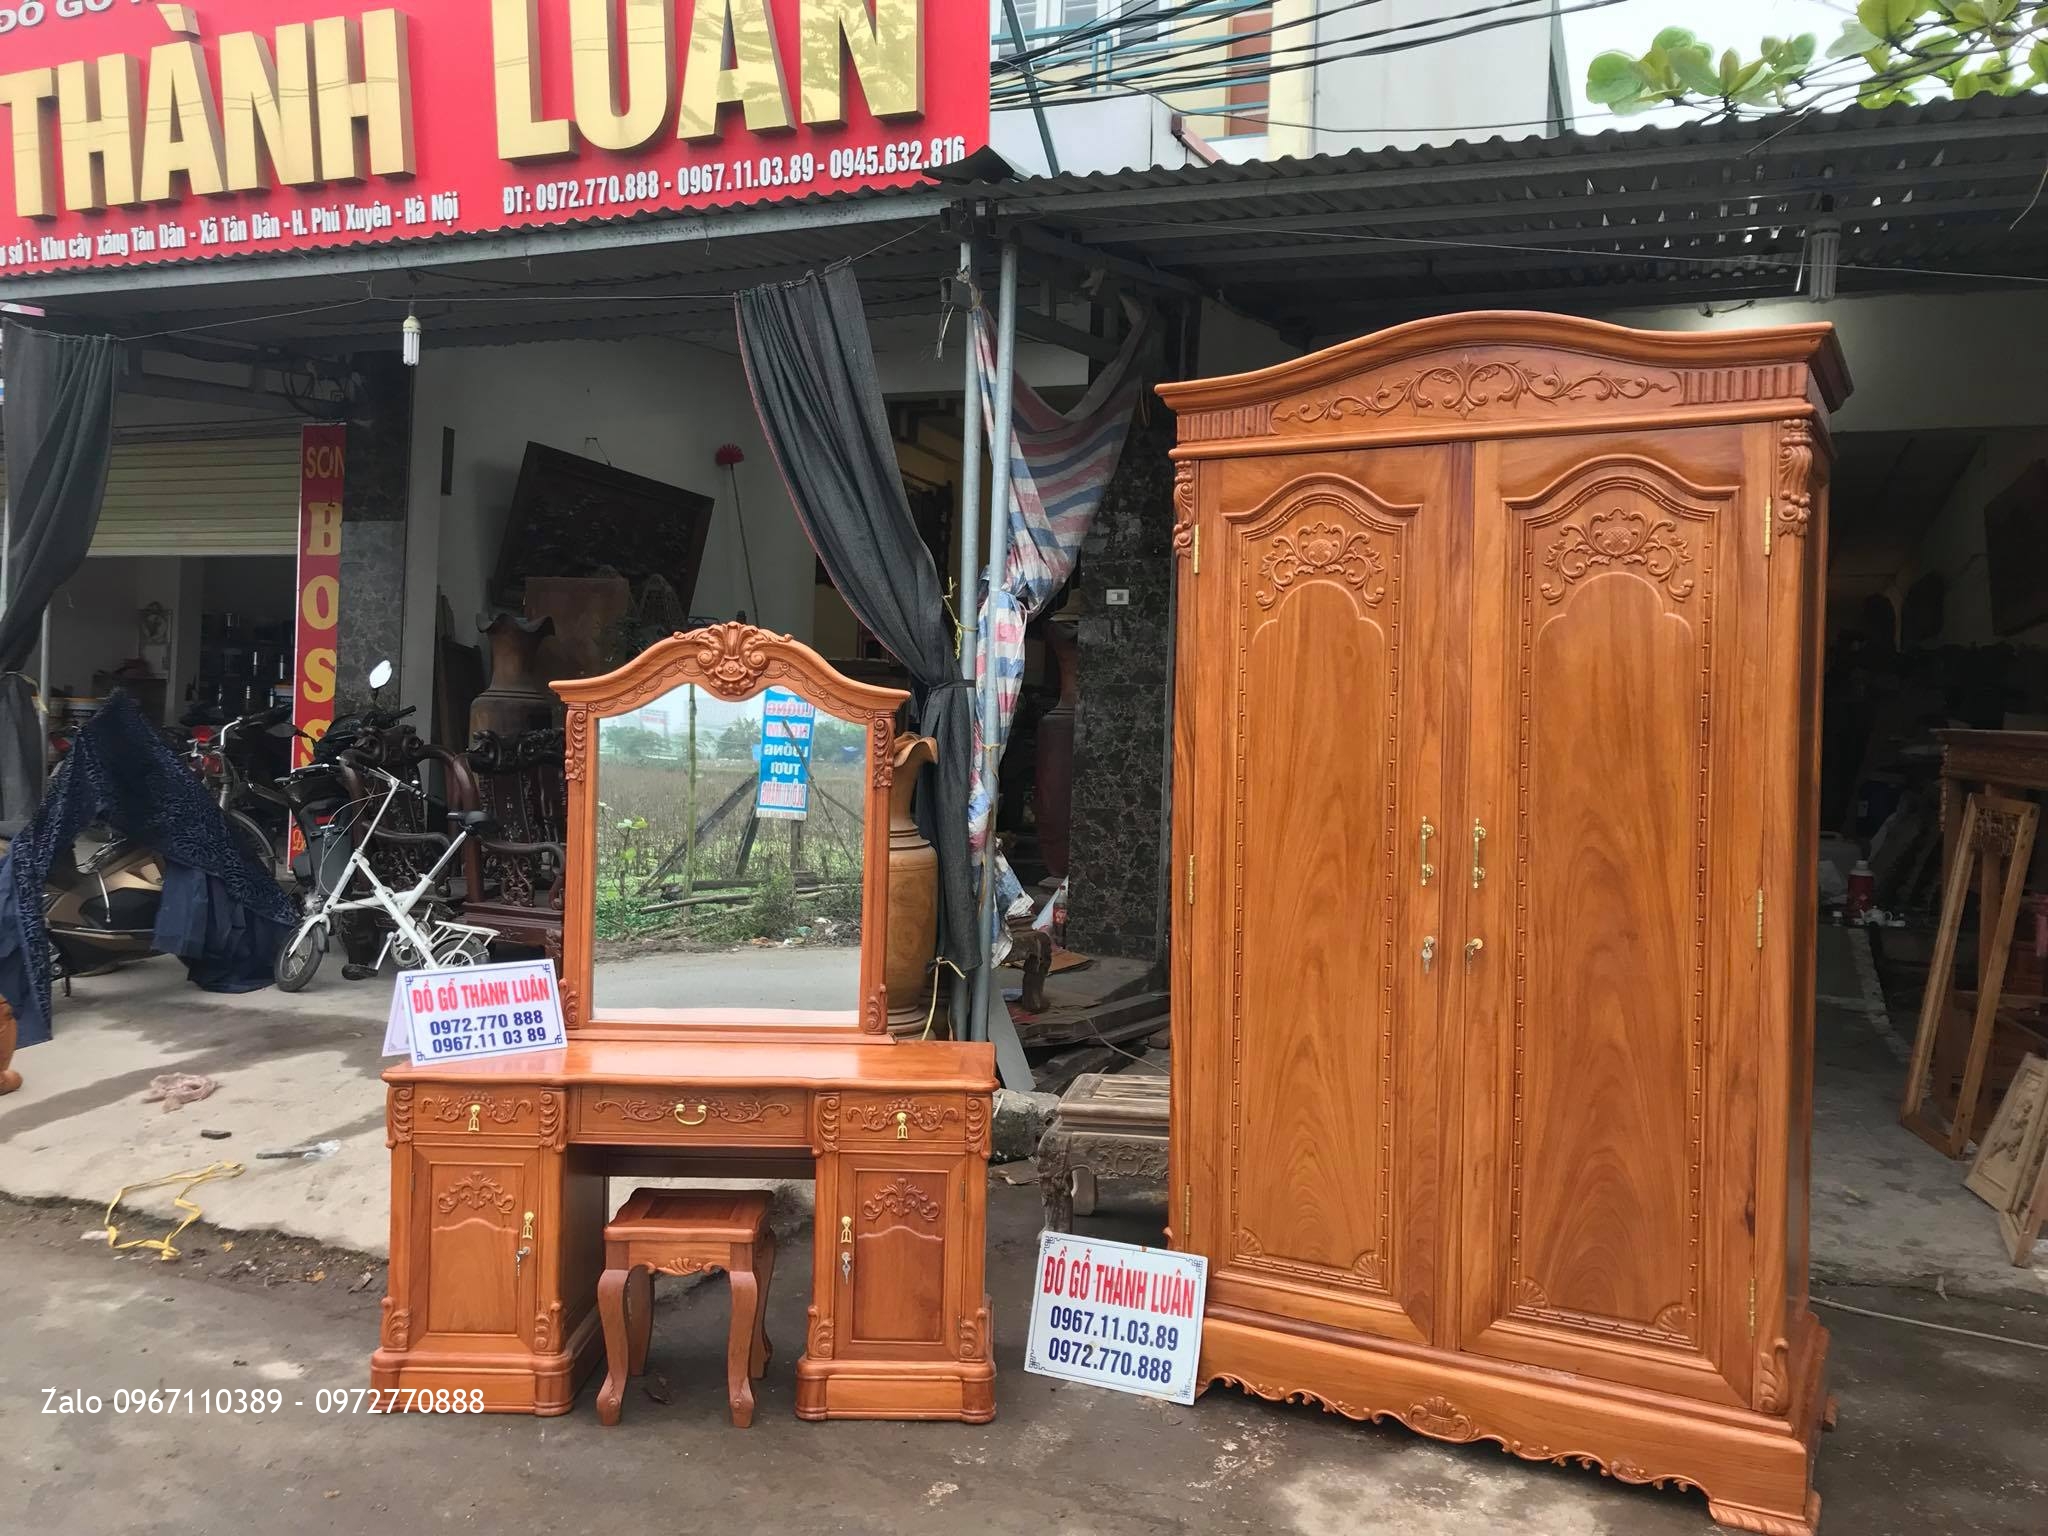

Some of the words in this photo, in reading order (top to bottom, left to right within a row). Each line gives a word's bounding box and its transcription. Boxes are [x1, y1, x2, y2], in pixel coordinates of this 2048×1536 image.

[0, 4, 414, 220] THÀNH
[503, 186, 532, 214] ĐT:
[536, 170, 659, 212] 0972.770.888
[678, 152, 814, 196] 0967.11.03.89
[830, 135, 966, 179] 0945.632.816
[41, 236, 67, 262] Khu
[69, 232, 92, 260] cây
[97, 229, 129, 257] xăng
[131, 225, 155, 252] Tân
[159, 221, 186, 249] Dân
[200, 217, 219, 245] Xã
[221, 216, 248, 243] Tân
[252, 211, 281, 240] Dân
[311, 204, 341, 234] Phú
[345, 200, 392, 233] Xuyên
[404, 195, 426, 225] Hà
[431, 191, 459, 226] Nội
[437, 978, 459, 1012] GỖ
[461, 978, 510, 1009] THÀNH
[513, 974, 550, 1004] LUÂN
[1043, 1246, 1068, 1296] ĐỒ
[1068, 1249, 1092, 1300] GỖ
[1095, 1260, 1149, 1311] THÀNH
[1151, 1269, 1196, 1319] LUÂN
[1049, 1337, 1172, 1384] 0972.770.888
[1050, 1305, 1179, 1351] 0967.11.03.89
